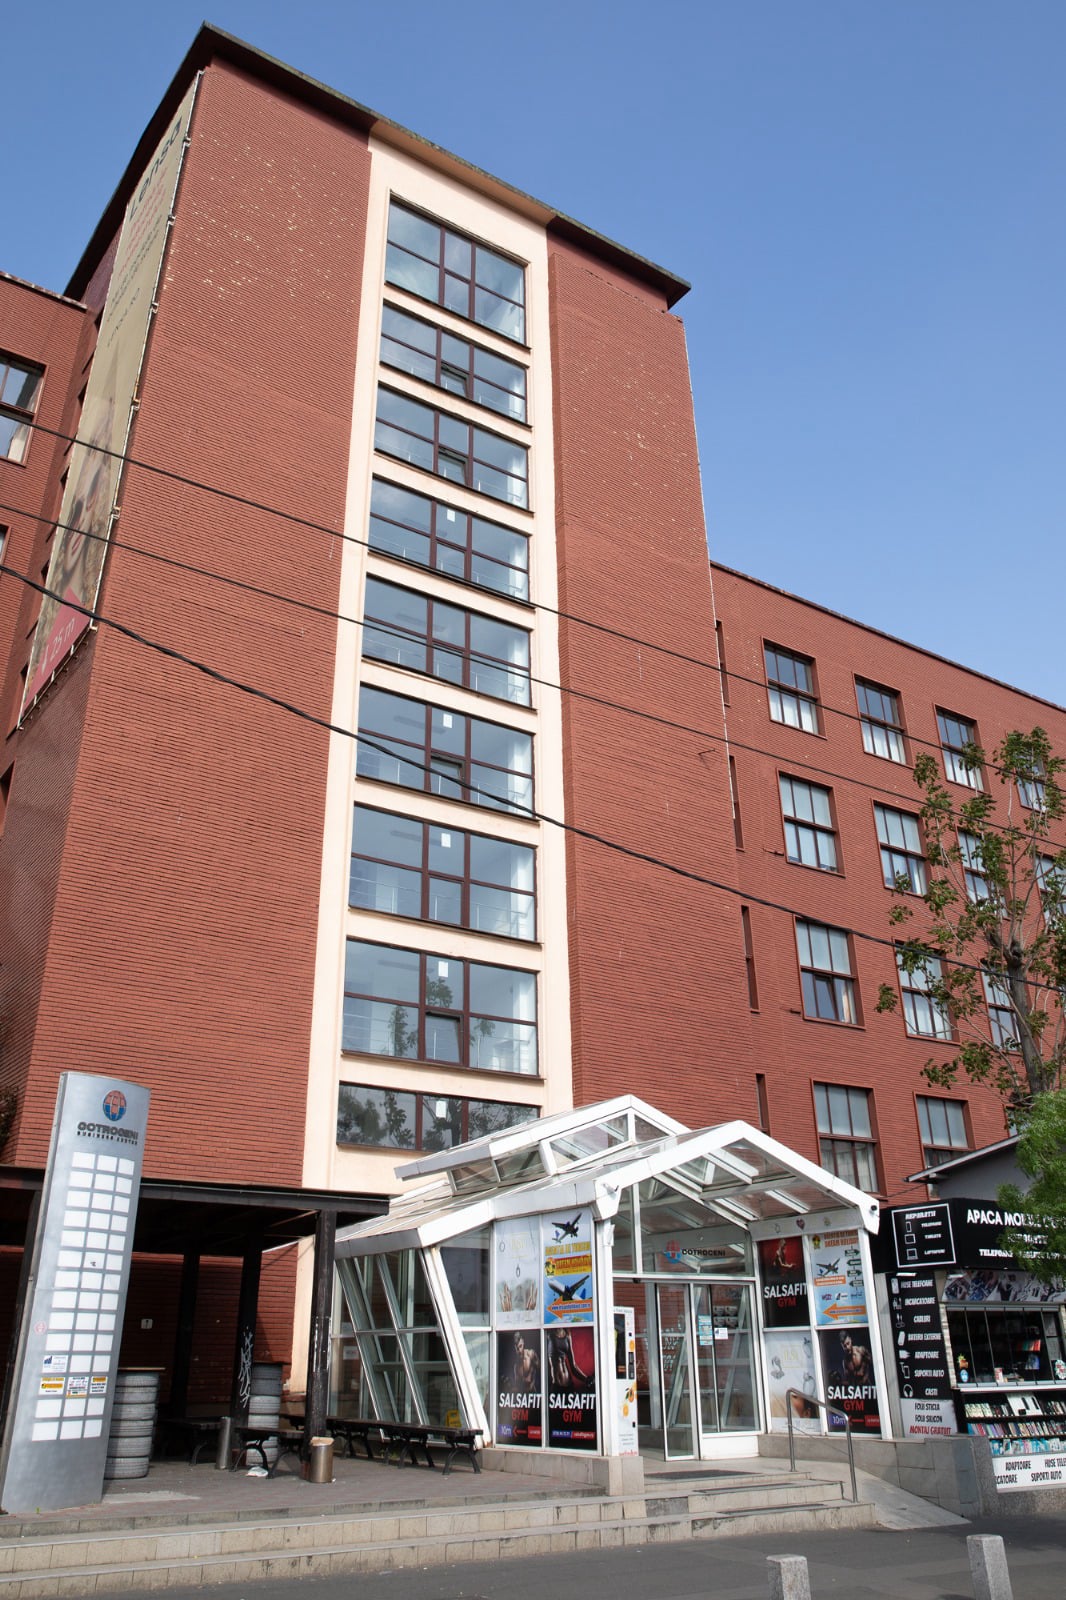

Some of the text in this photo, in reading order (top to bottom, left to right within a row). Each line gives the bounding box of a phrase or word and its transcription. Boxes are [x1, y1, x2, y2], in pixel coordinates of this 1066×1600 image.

[129, 116, 183, 222] Lensa
[77, 1121, 139, 1140] COTROCENI
[967, 1208, 1004, 1226] APACA
[681, 1248, 726, 1257] COTROCENI
[763, 1282, 808, 1299] SALSAFIT
[777, 1297, 797, 1308] GYM
[932, 1369, 945, 1378] AUTO
[827, 1385, 877, 1400] SALSAFIT
[499, 1392, 543, 1409] SALSAFIT
[549, 1393, 596, 1410] SALSAFIT
[843, 1399, 864, 1411] GYM
[511, 1408, 529, 1421] GYM
[562, 1410, 582, 1423] GYM
[925, 1415, 943, 1423] SILICON
[909, 1425, 952, 1436] MONTAJ GRATUIT
[1005, 1460, 1032, 1471] ADAPTOARE
[1044, 1458, 1056, 1468] HUSE
[1030, 1471, 1050, 1482] SUPORTI
[1050, 1470, 1063, 1480] AUTO
